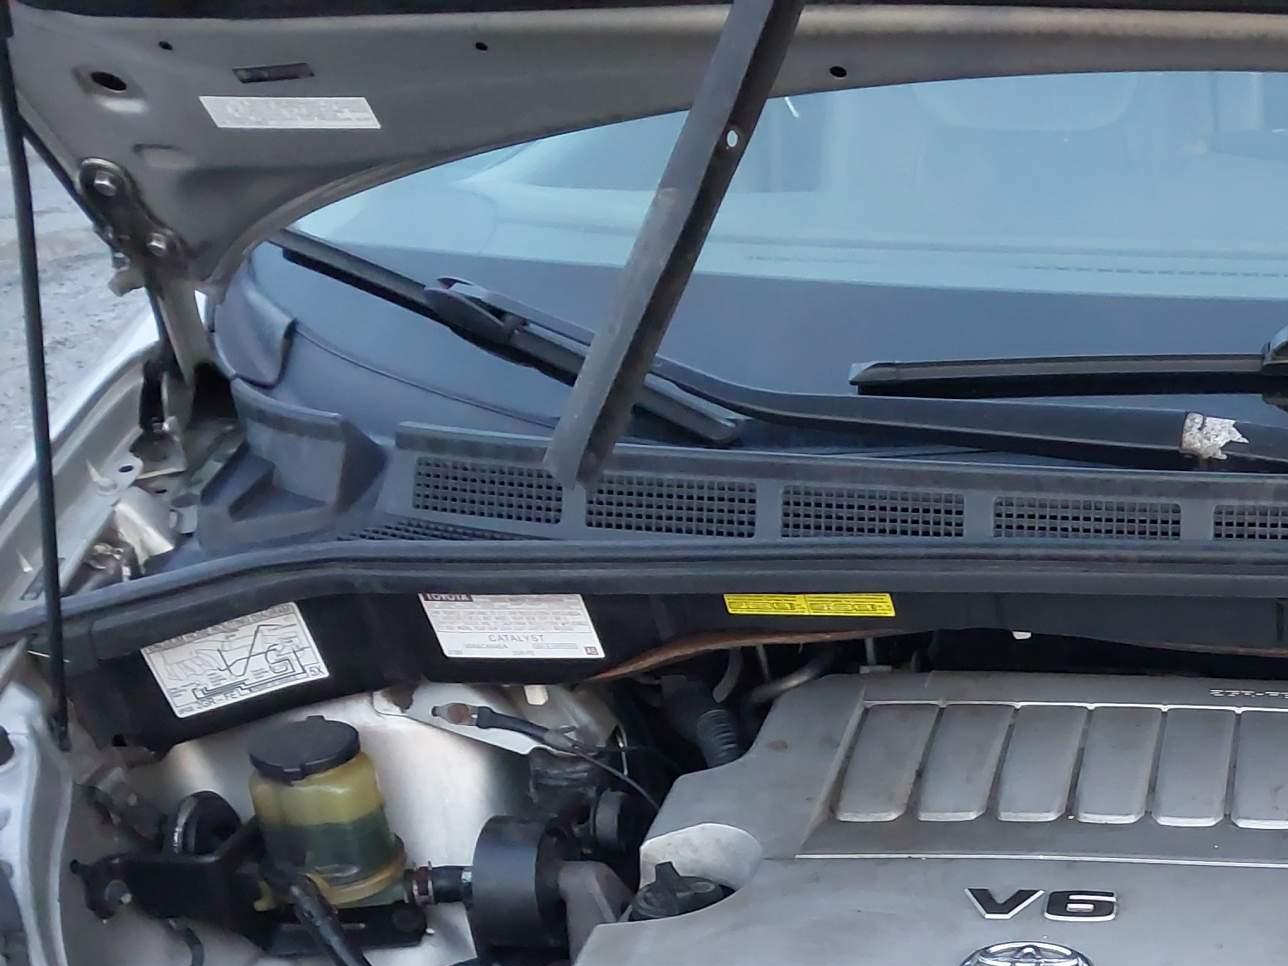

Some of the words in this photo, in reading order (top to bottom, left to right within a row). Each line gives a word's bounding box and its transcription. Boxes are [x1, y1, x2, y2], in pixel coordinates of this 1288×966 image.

[426, 593, 469, 602] TOYOTA
[487, 634, 546, 643] CATALYST
[964, 887, 1117, 923] V6
